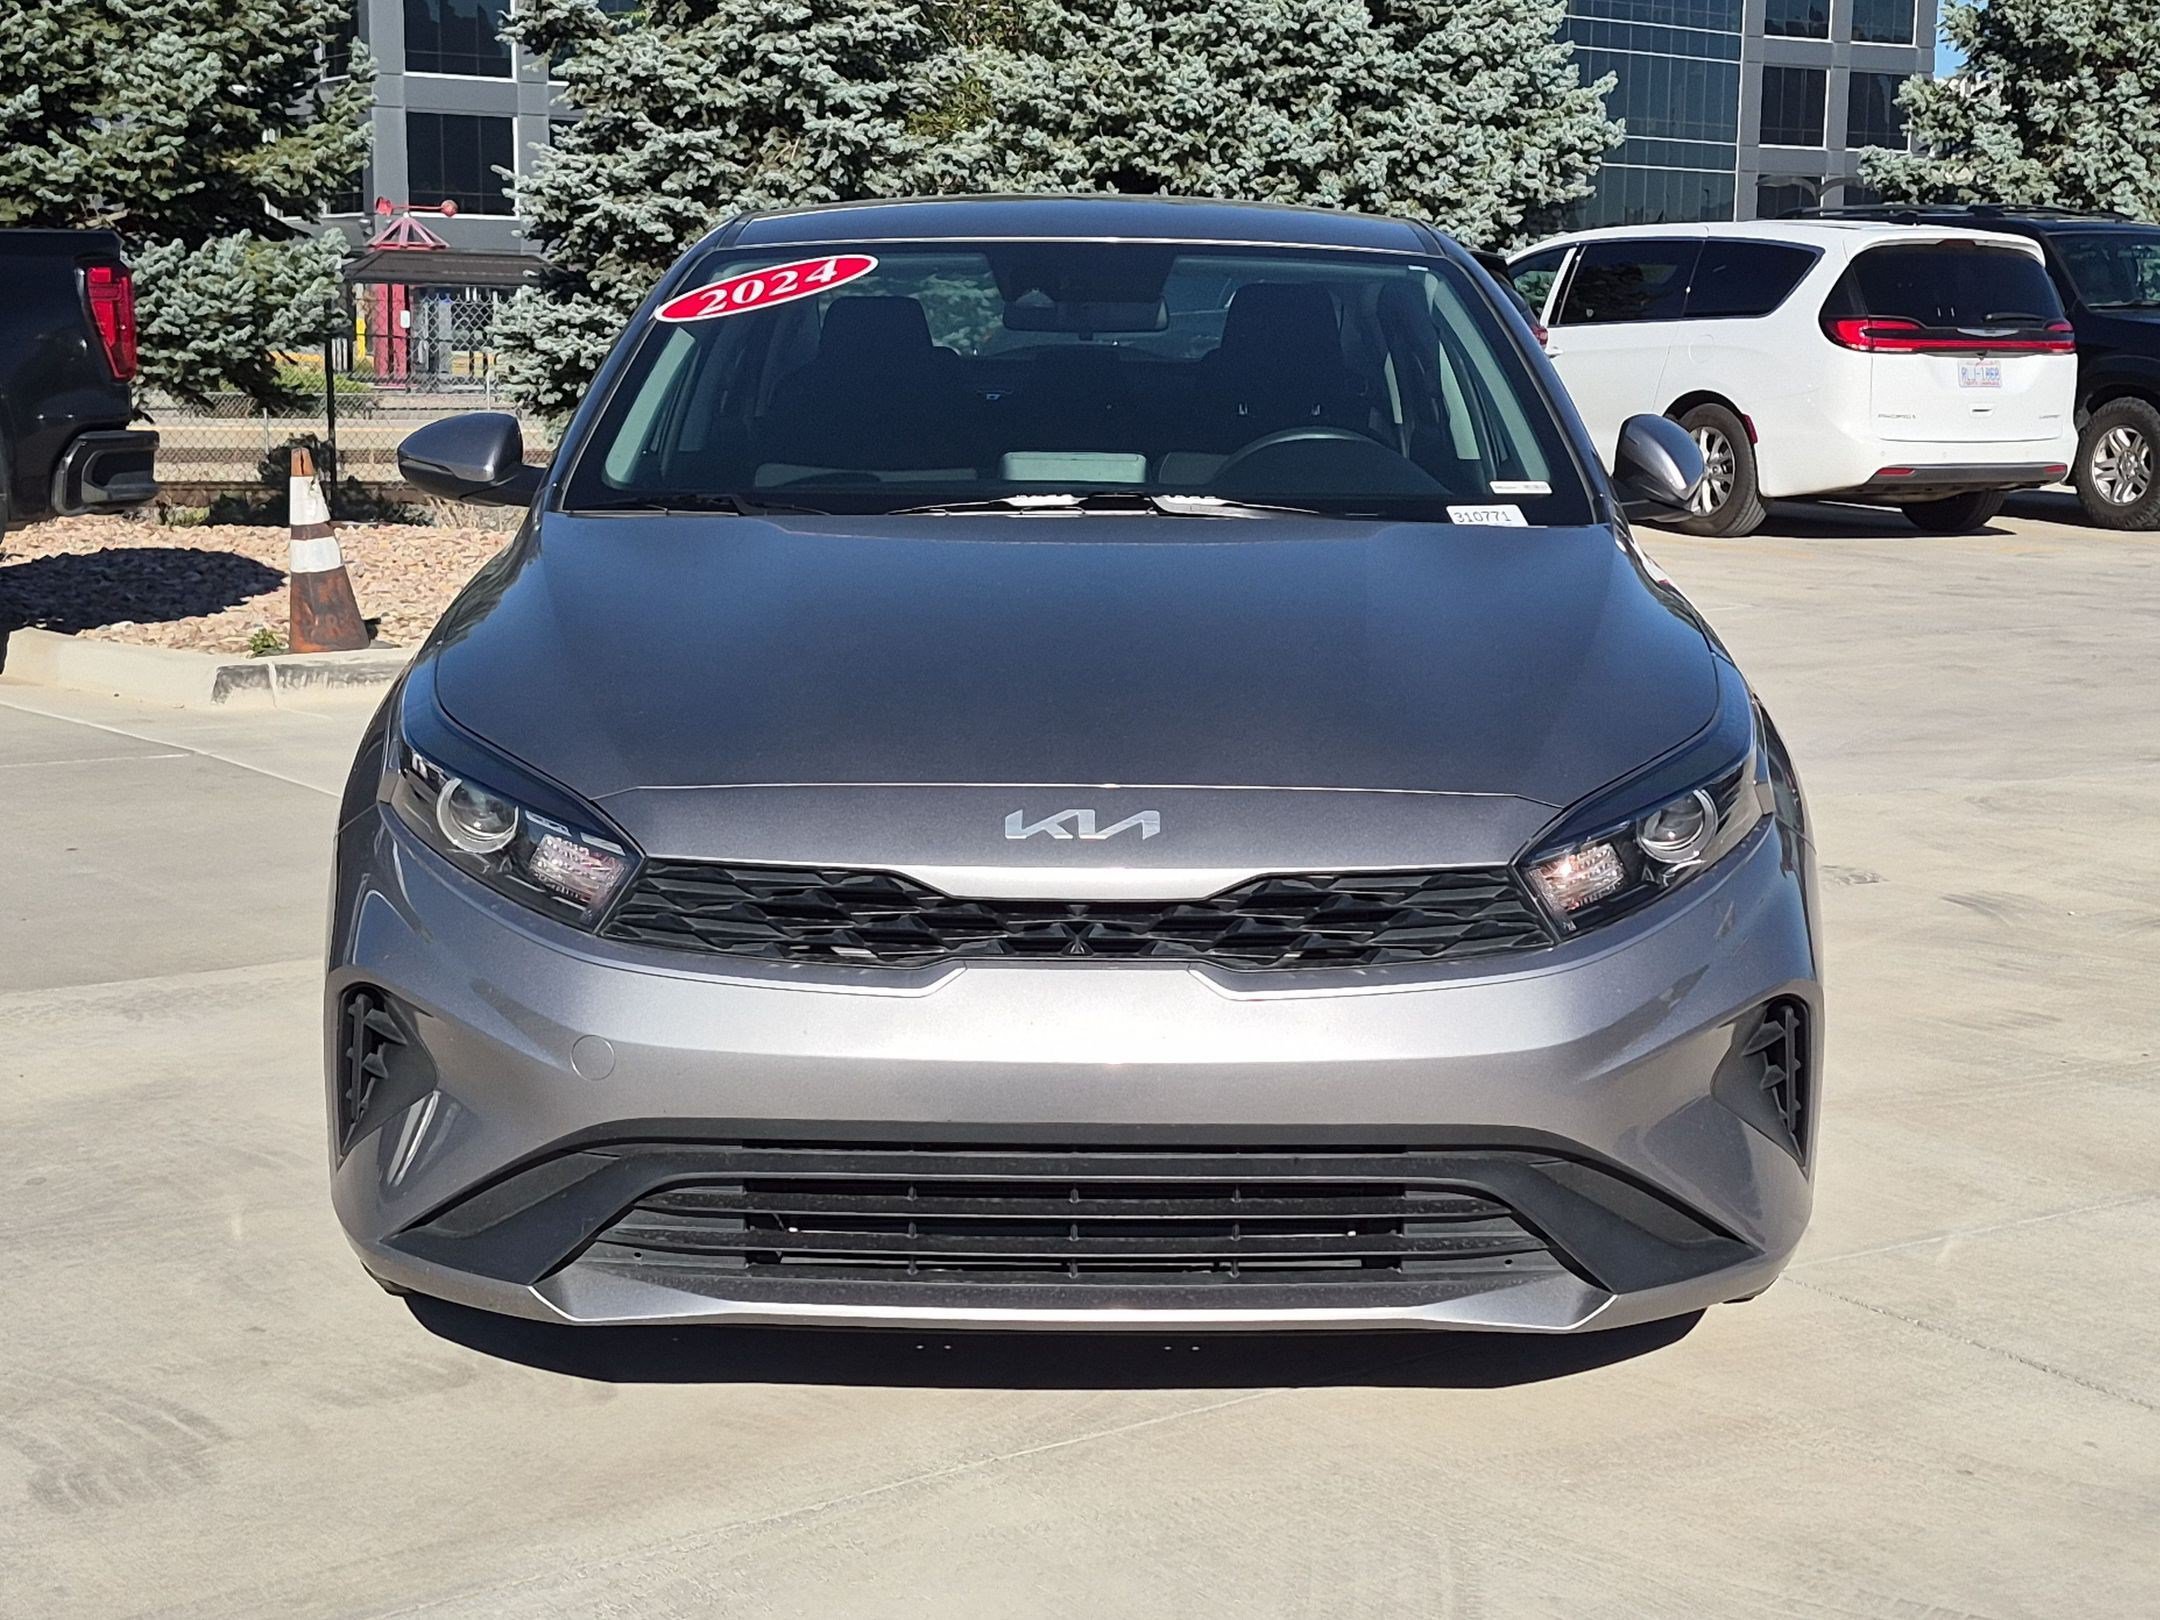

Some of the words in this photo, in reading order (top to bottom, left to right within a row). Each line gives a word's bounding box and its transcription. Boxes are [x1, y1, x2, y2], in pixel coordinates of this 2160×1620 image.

[697, 259, 838, 316] 2024
[1454, 511, 1511, 522] 310771
[1005, 808, 1161, 840] KIA
